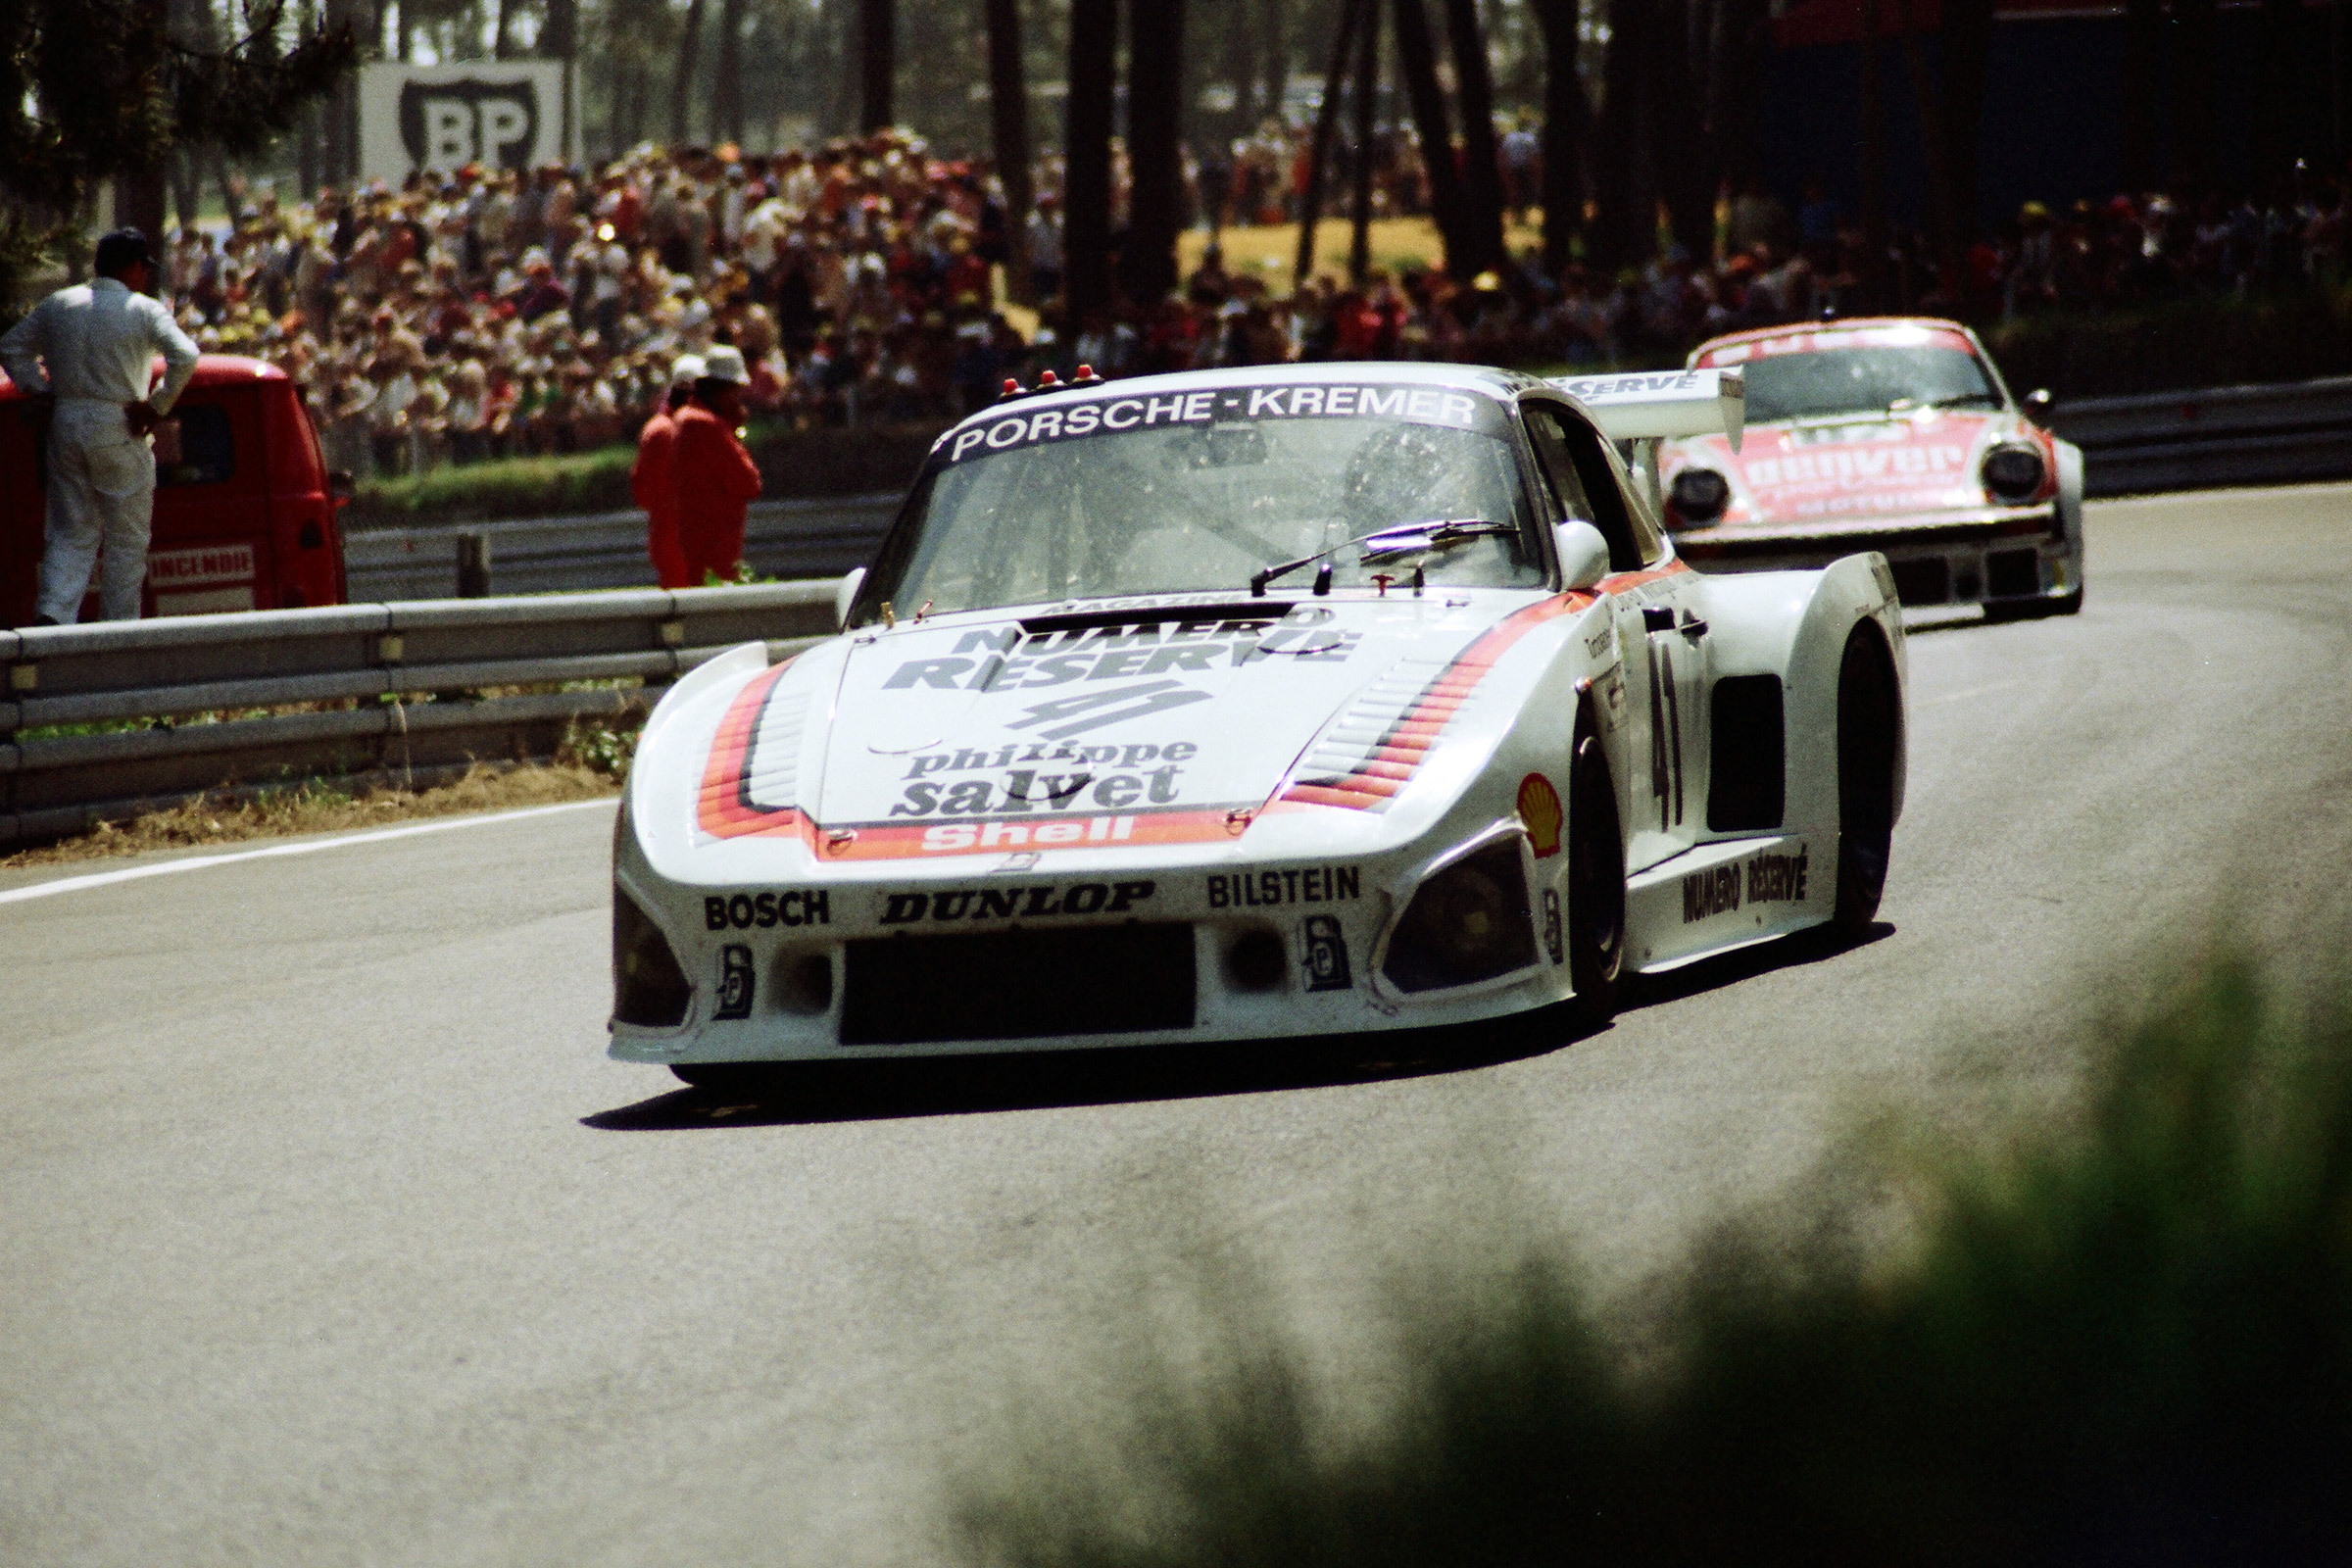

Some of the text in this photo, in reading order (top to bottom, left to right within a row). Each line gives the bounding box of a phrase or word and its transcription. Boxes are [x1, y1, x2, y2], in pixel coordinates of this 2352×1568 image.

[424, 99, 527, 171] BP
[951, 392, 1215, 462] PORSCHE
[1247, 387, 1475, 424] KREMER
[900, 740, 1198, 780] philippe
[889, 764, 1184, 816] salvet
[921, 815, 1135, 852] Shell
[881, 880, 1156, 925] DUNLOP
[1207, 865, 1360, 908] BILSTEIN
[705, 890, 830, 931] BOSCH
